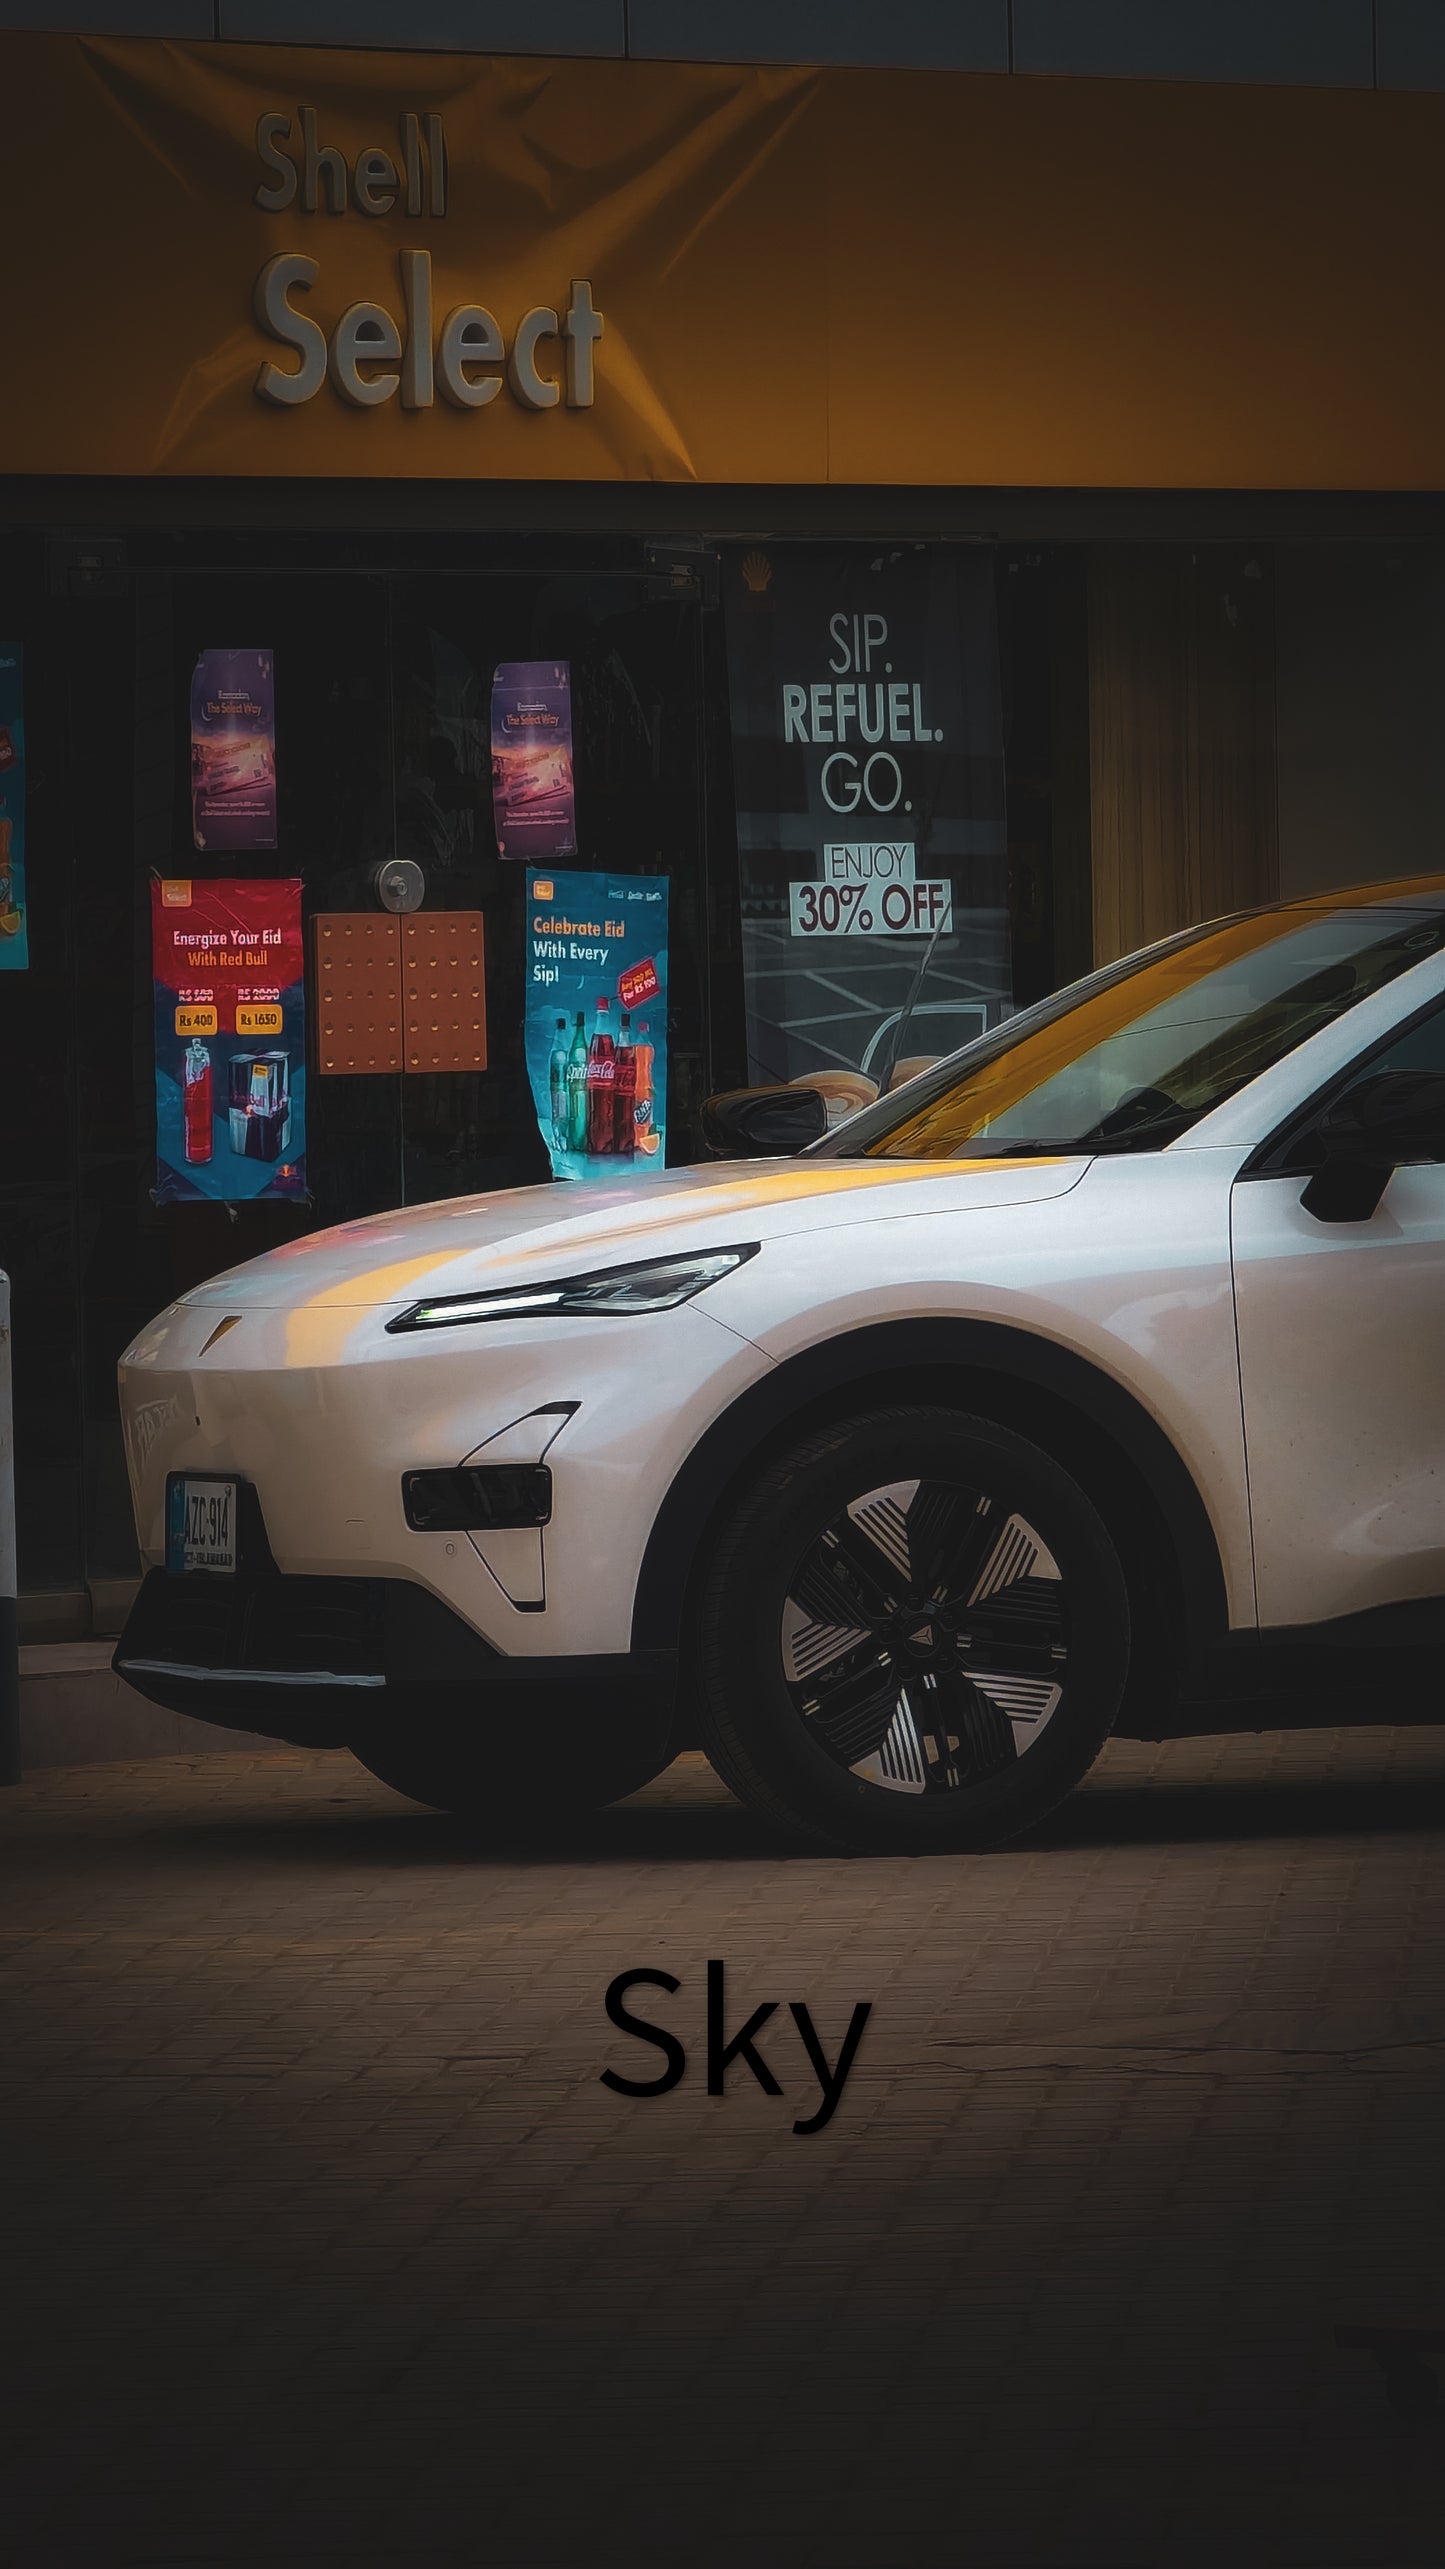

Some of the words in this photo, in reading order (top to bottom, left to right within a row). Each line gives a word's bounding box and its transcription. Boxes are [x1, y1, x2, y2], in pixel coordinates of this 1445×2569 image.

[256, 104, 448, 217] Shell
[255, 249, 604, 410] Select
[828, 613, 893, 674] SIP.
[783, 683, 944, 743] REFUEL.
[821, 752, 912, 813] GO.
[831, 845, 907, 878] ENJOY
[799, 882, 874, 933] 30%
[881, 883, 944, 930] OFF
[173, 929, 227, 949] Energize
[230, 929, 260, 945] Your
[262, 928, 281, 945] Eid
[533, 916, 601, 937] Celebrate
[604, 920, 625, 937] Eid
[187, 951, 217, 966] With
[219, 951, 242, 967] Red
[245, 950, 268, 966] Bull
[533, 940, 566, 959] With
[569, 942, 609, 966] Every
[179, 1015, 192, 1027] Rs
[193, 1014, 213, 1027] 400
[240, 1014, 252, 1026] Rs
[254, 1013, 277, 1026] 1650
